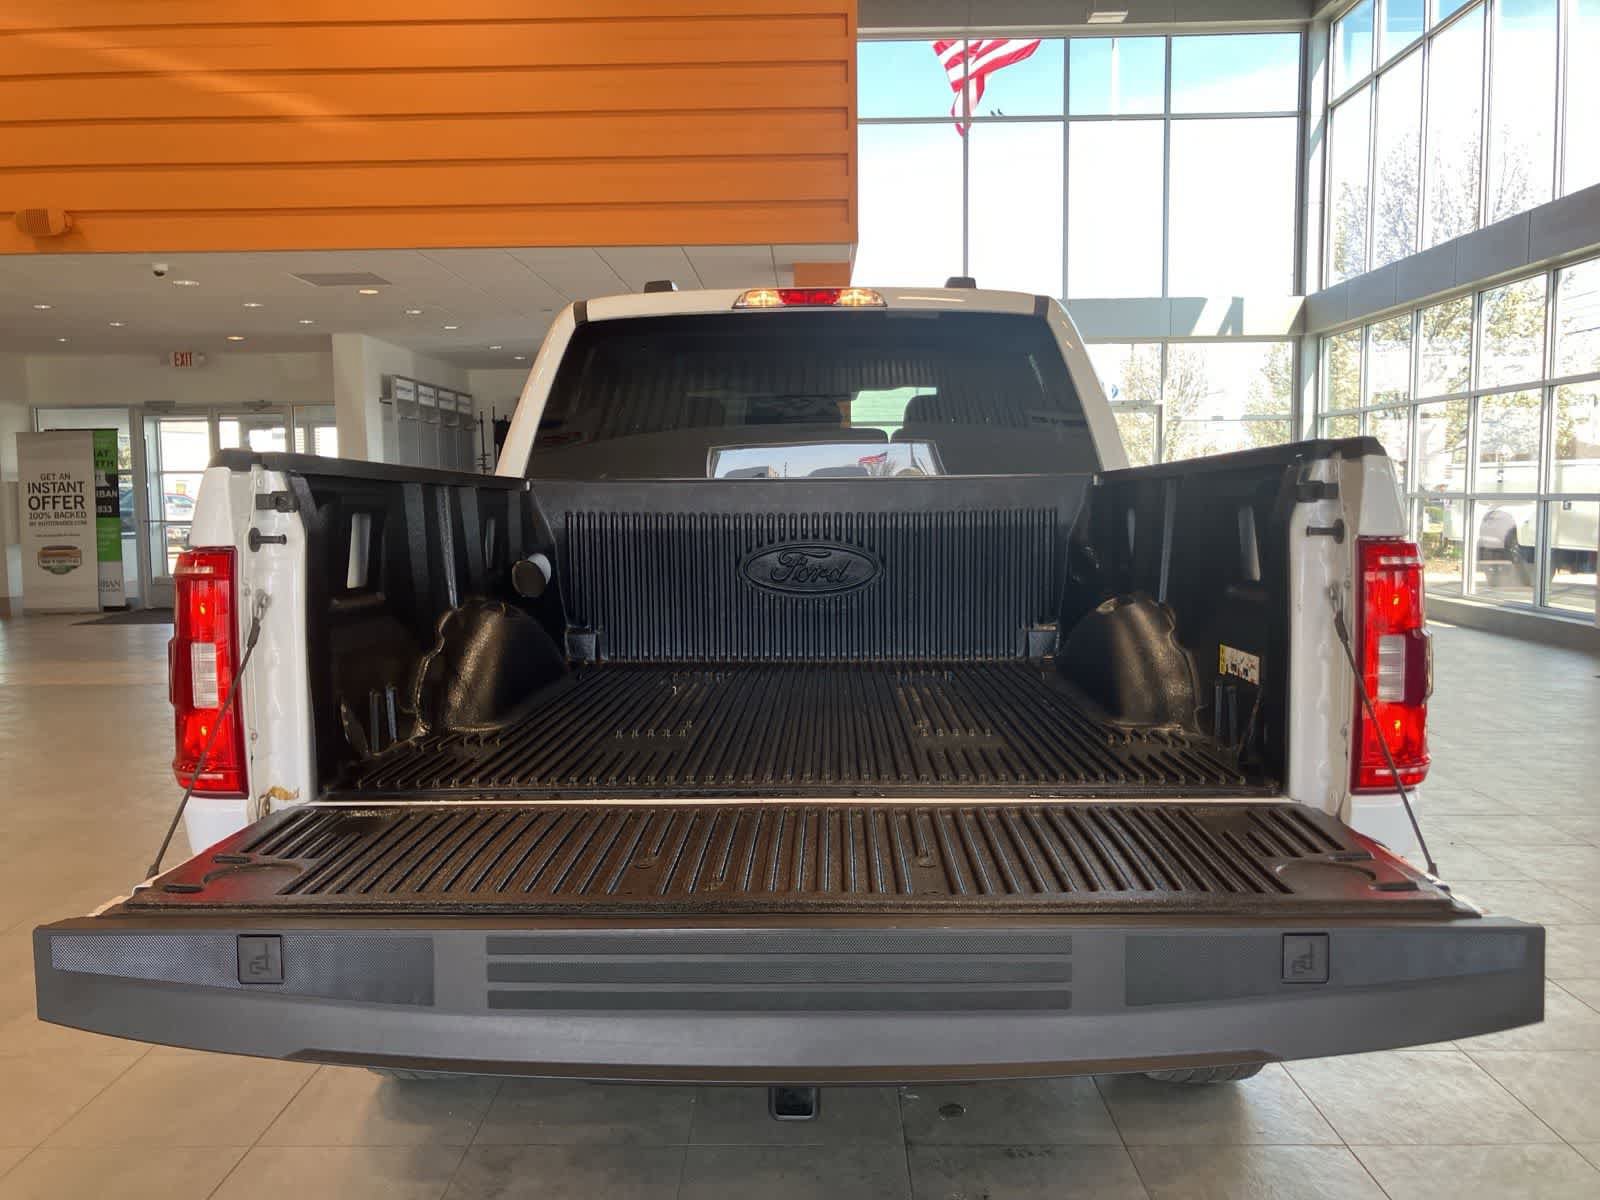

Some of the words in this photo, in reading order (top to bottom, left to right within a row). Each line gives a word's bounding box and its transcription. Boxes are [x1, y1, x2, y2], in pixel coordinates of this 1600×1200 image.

[174, 351, 192, 367] EXIT
[40, 473, 56, 481] GET
[59, 472, 71, 480] AN
[28, 481, 85, 494] INSTANT
[28, 495, 85, 511] OFFER
[29, 512, 52, 520] 100%
[54, 511, 87, 520] BACKED
[769, 549, 853, 584] Ford
